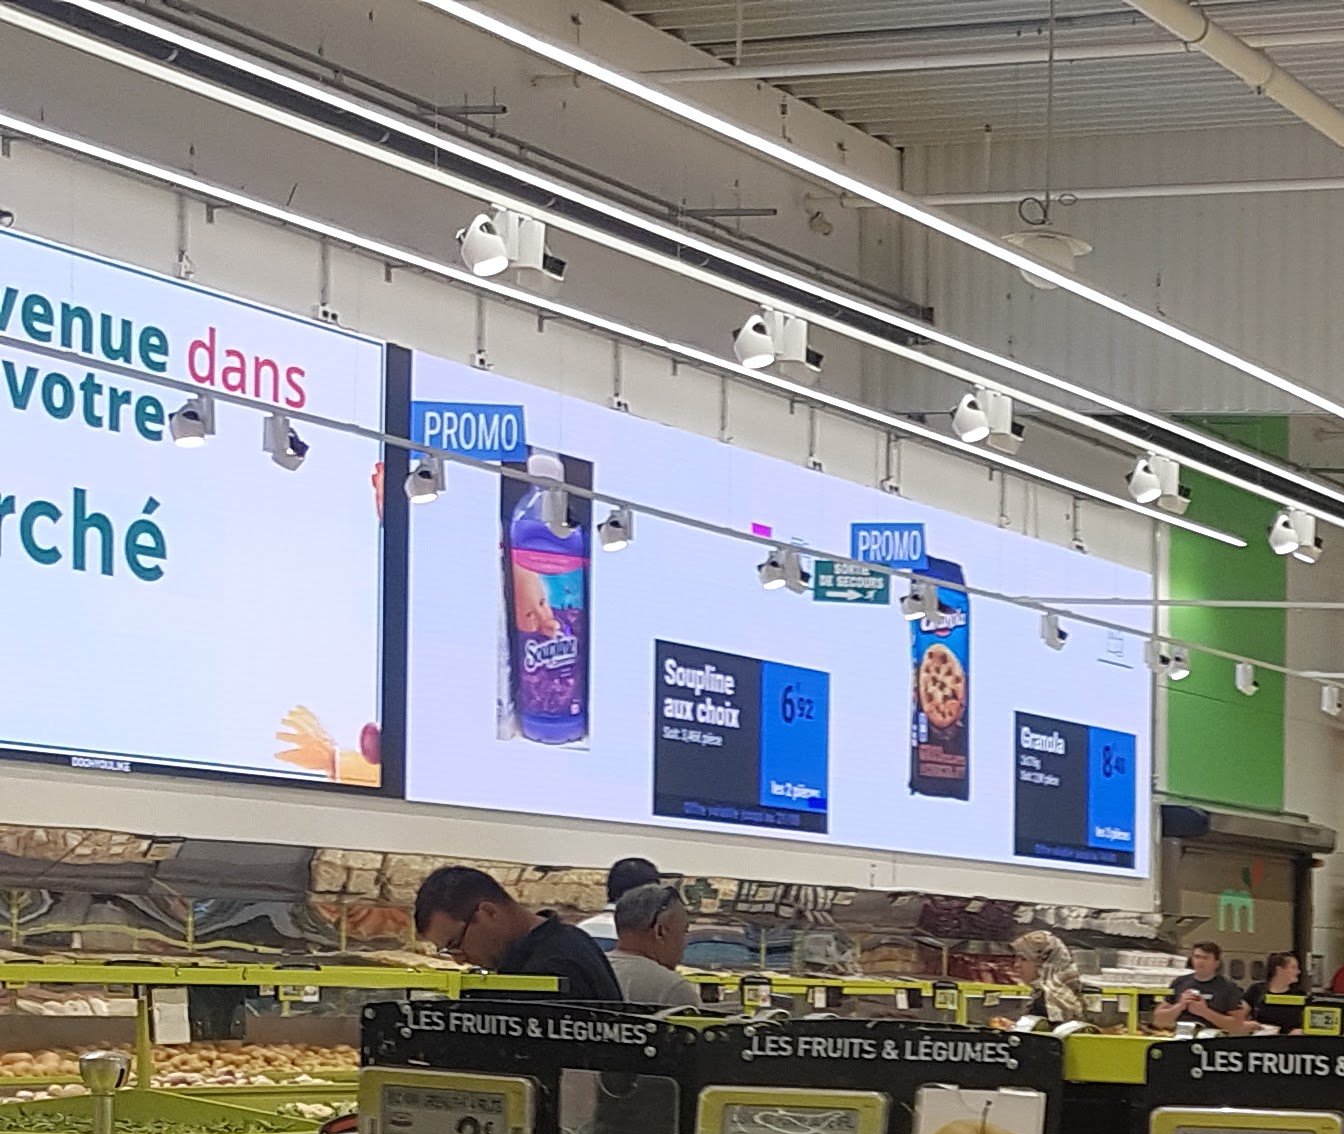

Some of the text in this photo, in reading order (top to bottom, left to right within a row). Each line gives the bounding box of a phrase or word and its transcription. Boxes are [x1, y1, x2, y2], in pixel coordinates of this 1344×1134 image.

[187, 327, 308, 410] dans
[5, 357, 166, 443] votre
[423, 409, 519, 452] PROMO
[857, 529, 922, 561] PROMO
[663, 658, 736, 697] Soupline
[663, 697, 741, 729] aux choix
[408, 1009, 648, 1046] LES FRUITS & LÉGUMES
[751, 1035, 1011, 1065] LES FRUITS & LÉGUMES
[1201, 1050, 1243, 1073] LES
[1248, 1053, 1330, 1076] FRUITS
